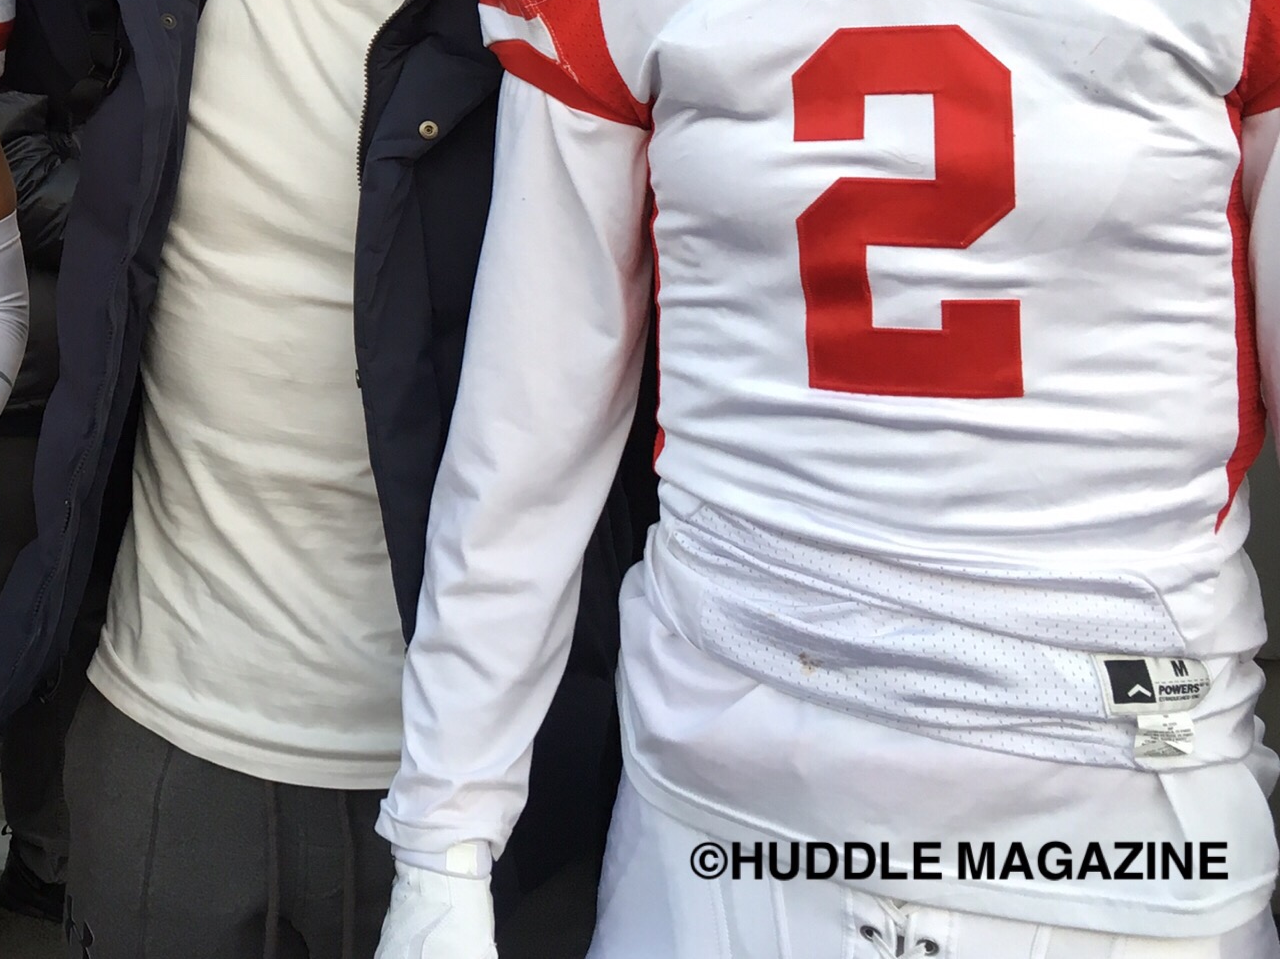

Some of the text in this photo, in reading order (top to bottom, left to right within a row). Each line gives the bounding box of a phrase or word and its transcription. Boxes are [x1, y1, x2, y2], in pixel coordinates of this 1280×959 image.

[791, 24, 1025, 400] 2
[1170, 659, 1189, 677] M
[1158, 683, 1200, 695] POWERS
